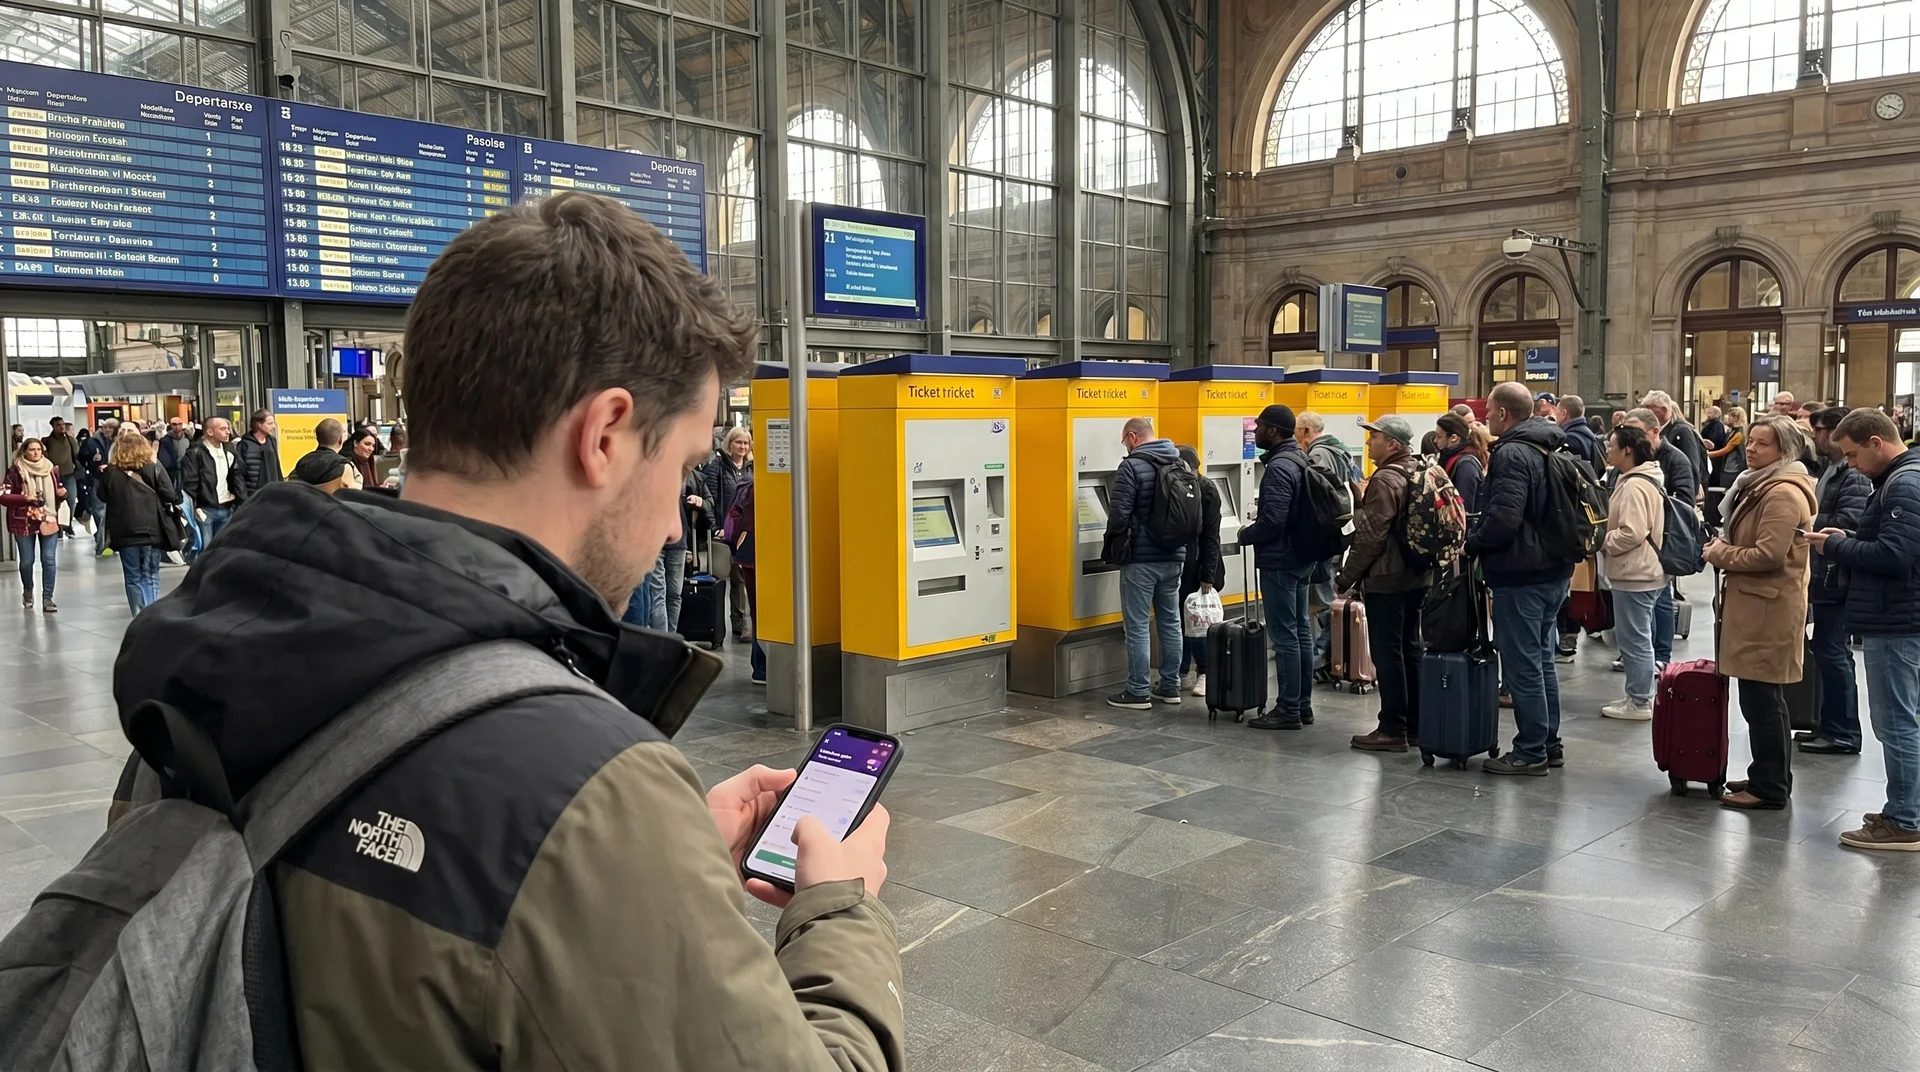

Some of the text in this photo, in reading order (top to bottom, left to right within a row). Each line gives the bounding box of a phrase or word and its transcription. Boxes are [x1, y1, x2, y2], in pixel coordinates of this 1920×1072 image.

[206, 132, 211, 140] 1
[206, 148, 212, 156] 2
[207, 164, 212, 172] 1
[650, 160, 698, 176] Deportures
[208, 179, 214, 188] 2
[467, 180, 472, 188] 3
[208, 196, 214, 204] 4
[467, 194, 472, 202] 3
[210, 212, 216, 220] 2
[211, 227, 216, 236] 1
[824, 232, 836, 244] 21
[212, 242, 217, 252] 2
[212, 258, 218, 267] 2
[214, 274, 219, 282] 0
[217, 368, 228, 380] D
[908, 386, 940, 398] Ticket
[1077, 388, 1102, 399] Ticket
[1206, 390, 1227, 400] Ticket
[378, 810, 407, 834] THE
[348, 818, 402, 849] NORTH
[356, 838, 398, 863] FACE
